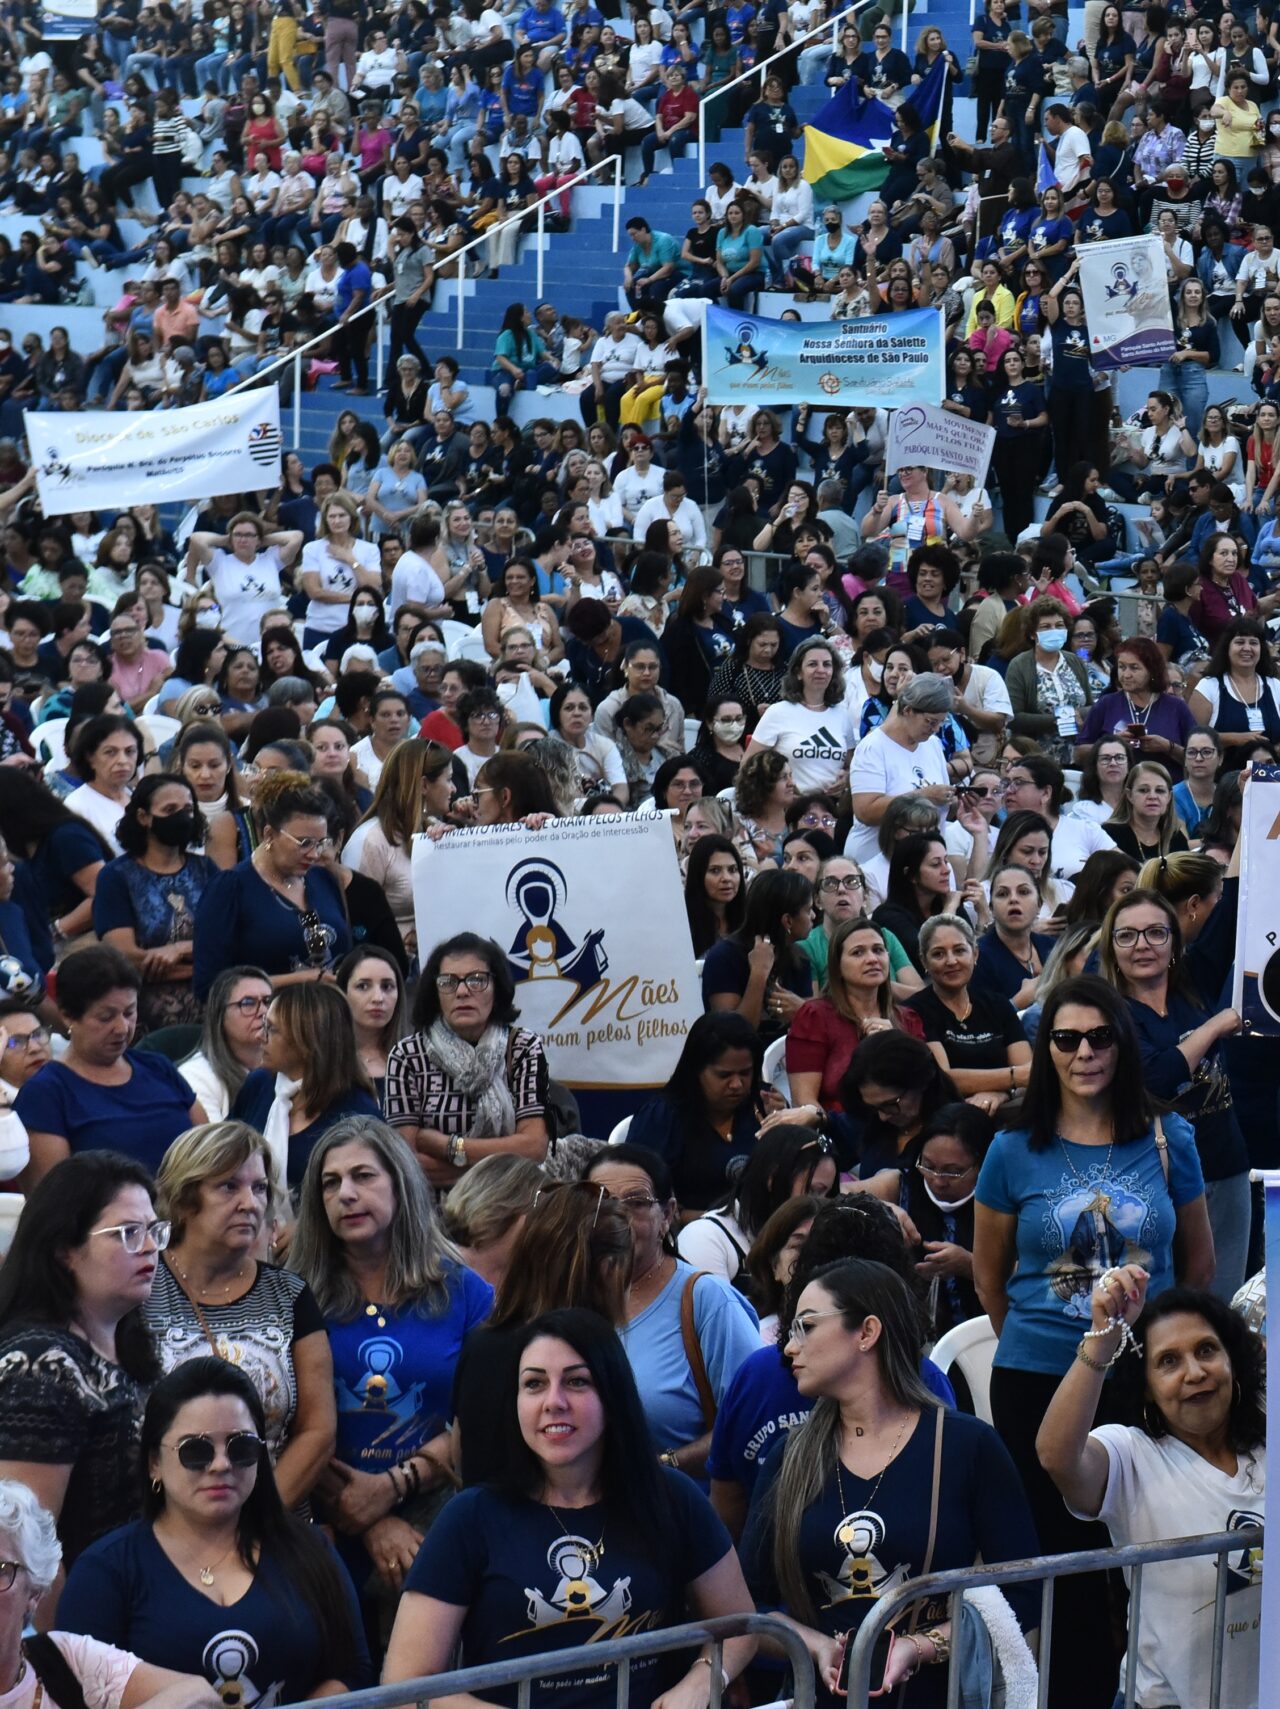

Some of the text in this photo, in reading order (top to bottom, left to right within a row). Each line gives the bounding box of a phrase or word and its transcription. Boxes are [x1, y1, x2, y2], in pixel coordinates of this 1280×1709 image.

[841, 323, 888, 335] Santuário
[803, 336, 926, 349] Nossa Senhora da Salette
[799, 350, 929, 365] Arquidiocese de São Paulo
[75, 414, 241, 444] Diocee de São Carlos
[940, 449, 963, 461] SANTO
[506, 835, 523, 846] pelo
[524, 833, 548, 845] poder
[550, 832, 560, 841] da
[561, 829, 589, 840] Oração
[591, 828, 601, 837] de
[603, 826, 649, 837] Intercessão
[586, 1018, 689, 1050] pelos filhos
[743, 1410, 811, 1461] GRUPO SAN
[1227, 1620, 1249, 1640] que
